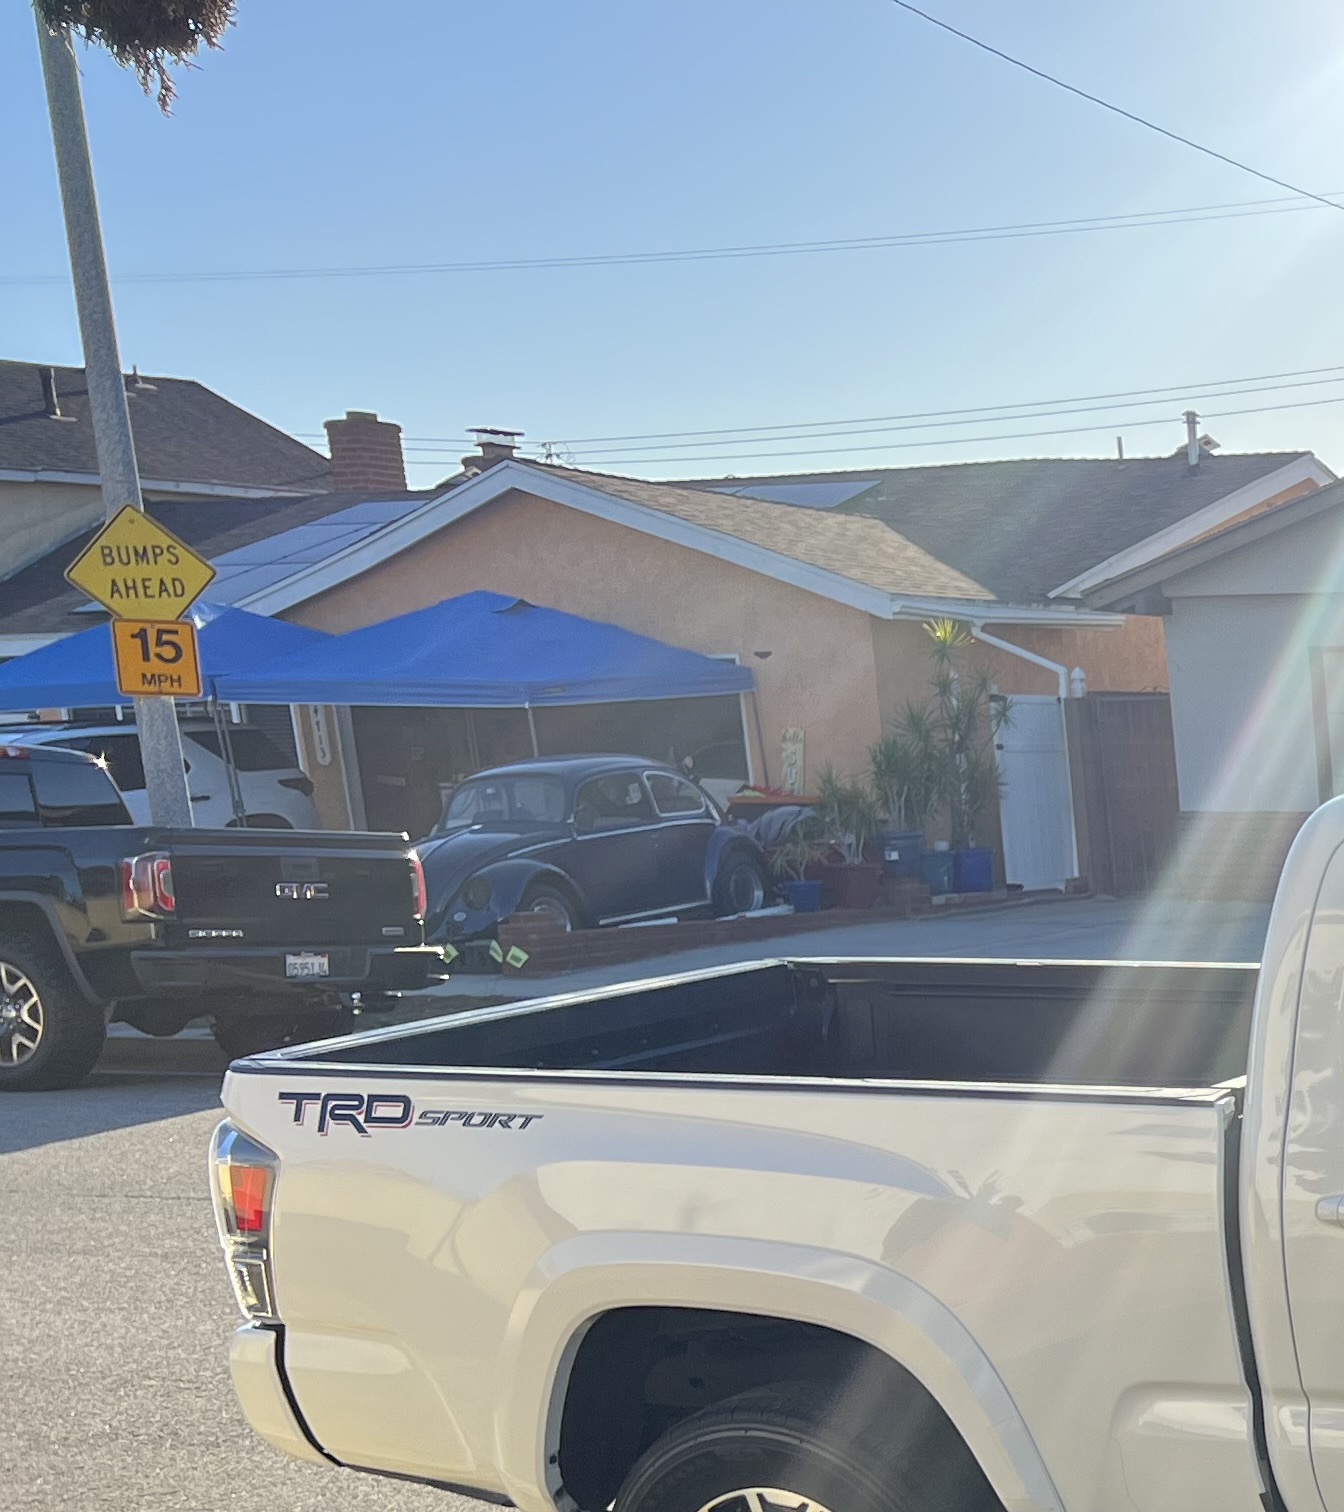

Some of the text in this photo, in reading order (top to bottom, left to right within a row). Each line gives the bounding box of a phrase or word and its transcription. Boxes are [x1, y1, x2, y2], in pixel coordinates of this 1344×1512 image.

[100, 544, 180, 567] BUMPS
[109, 576, 185, 600] AHEAD
[131, 627, 183, 664] 15
[141, 672, 182, 690] MPH
[278, 1091, 544, 1137] TRD SPORT
